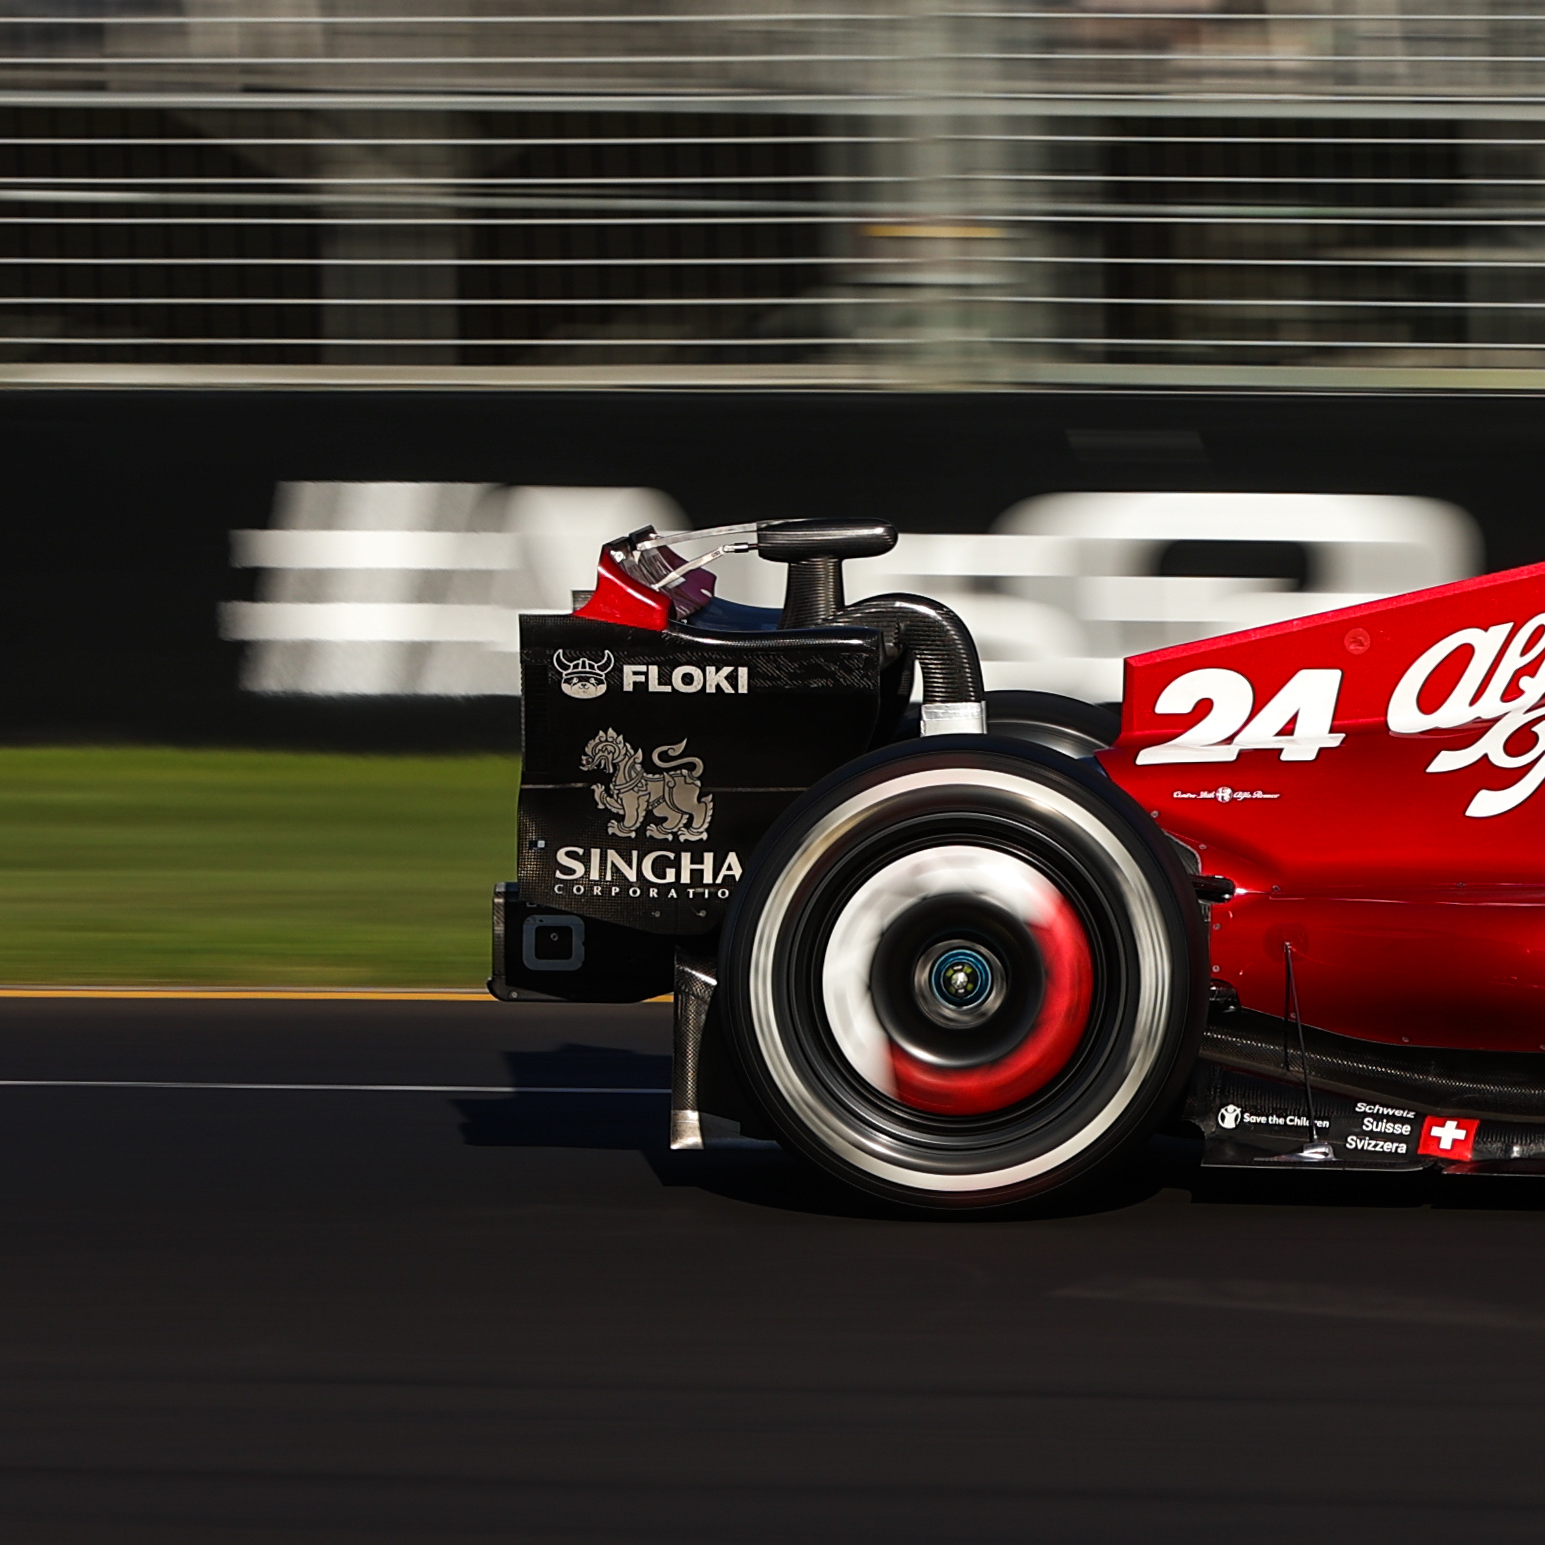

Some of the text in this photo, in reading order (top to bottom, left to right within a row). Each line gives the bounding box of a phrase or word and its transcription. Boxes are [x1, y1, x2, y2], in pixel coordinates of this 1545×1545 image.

[622, 665, 748, 694] FLOKI
[1135, 668, 1346, 765] 24
[554, 846, 743, 885] SINGHA
[553, 884, 730, 899] CORPORATIO
[1243, 1113, 1267, 1124] Save
[1268, 1114, 1284, 1125] the
[1355, 1102, 1416, 1119] Schweiz
[1362, 1117, 1411, 1135] Suisse
[1345, 1135, 1407, 1154] Svizzera
